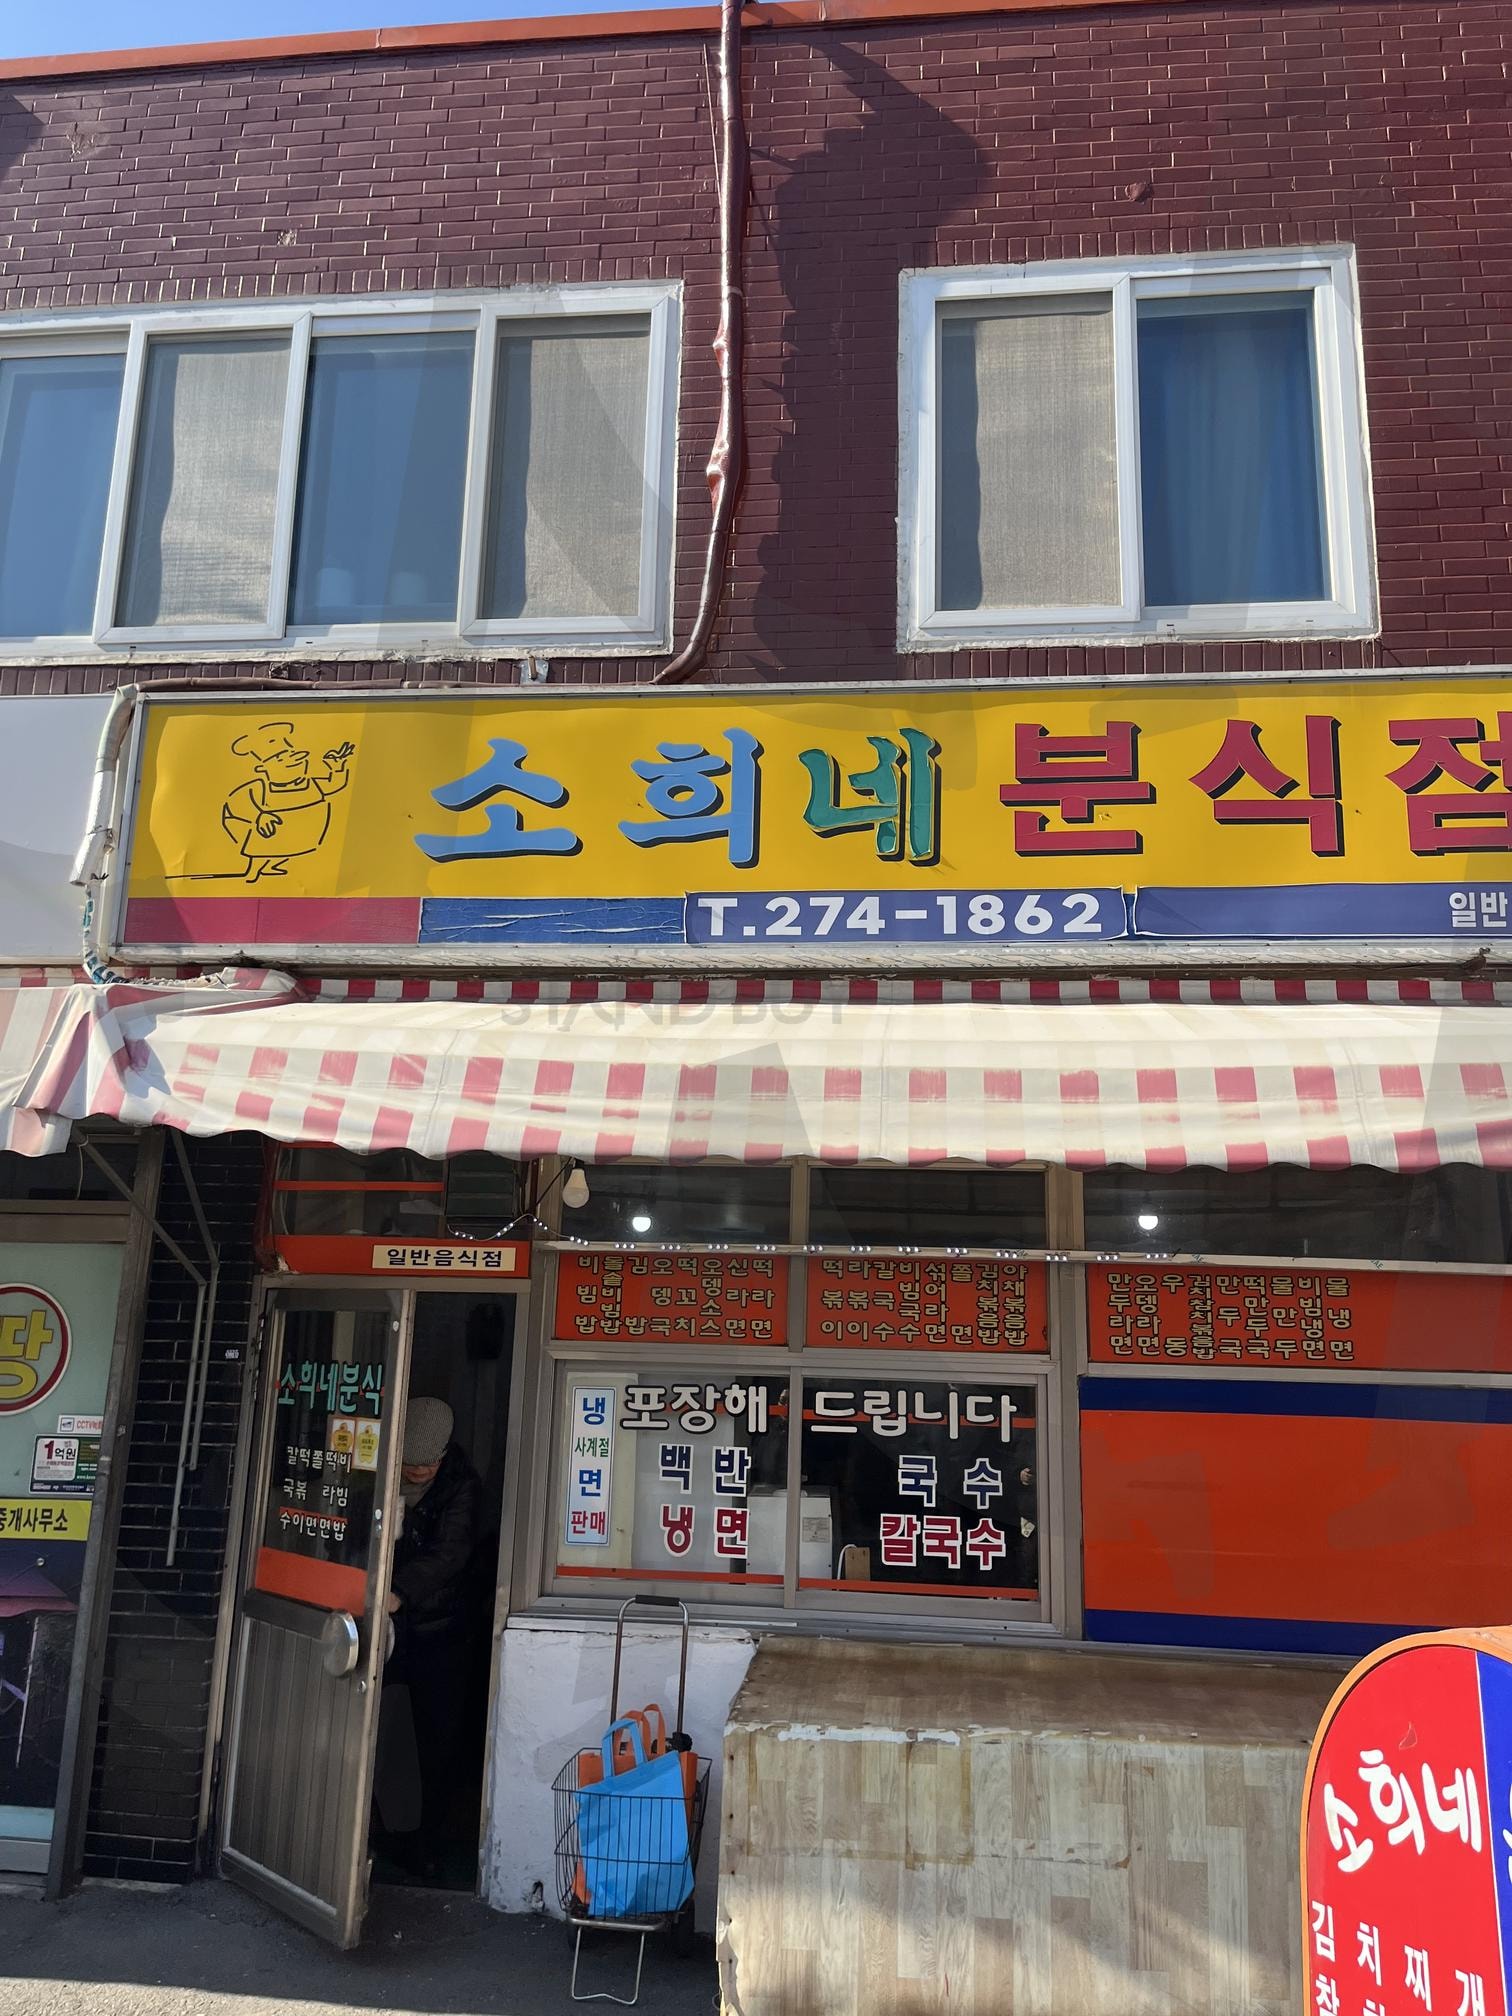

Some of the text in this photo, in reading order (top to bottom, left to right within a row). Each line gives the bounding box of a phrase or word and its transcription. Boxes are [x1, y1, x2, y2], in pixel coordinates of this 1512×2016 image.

[414, 711, 1512, 866] 소희네 분식점
[698, 892, 1102, 936] T.274-1862
[1449, 891, 1508, 928] 일반
[387, 1248, 502, 1267] 일반음식점
[575, 1255, 599, 1334] 비빔밥
[600, 1255, 625, 1335] 돌솥비빔밥
[625, 1255, 649, 1335] 김밥
[649, 1258, 673, 1337] 오뎅국
[674, 1257, 698, 1337] 떡꼬치
[699, 1258, 723, 1337] 오뎅소스
[725, 1258, 750, 1338] 신라면
[751, 1259, 775, 1339] 떡라면
[821, 1260, 844, 1340] 떡볶이
[846, 1260, 871, 1341] 라볶이
[872, 1260, 897, 1341] 칼국수
[898, 1261, 921, 1342] 비빔국수
[924, 1262, 949, 1343] 섞어라면
[950, 1263, 973, 1344] 쫄면
[976, 1263, 1001, 1345] 김치볶음밥
[1002, 1264, 1028, 1346] 야채볶음밥
[1107, 1273, 1133, 1355] 만두라면
[1134, 1274, 1161, 1355] 오뎅라면
[1161, 1274, 1187, 1356] 우동
[1216, 1275, 1242, 1359] 만두국
[1243, 1276, 1270, 1359] 떡만두국
[1270, 1276, 1298, 1360] 물만두
[1298, 1276, 1326, 1360] 비빔냉면
[1326, 1277, 1354, 1360] 물냉면
[278, 1360, 383, 1416] 소희네분식
[582, 1396, 606, 1426] 냉
[620, 1384, 1018, 1443] 포장해 드립니다
[574, 1436, 610, 1458] 사계절
[578, 1469, 602, 1497] 면
[659, 1443, 752, 1498] 백반
[898, 1455, 1003, 1510] 국수
[570, 1510, 606, 1536] 판매
[660, 1503, 750, 1559] 냉면
[880, 1513, 1007, 1571] 칼국수
[1323, 1748, 1482, 1873] 소희네
